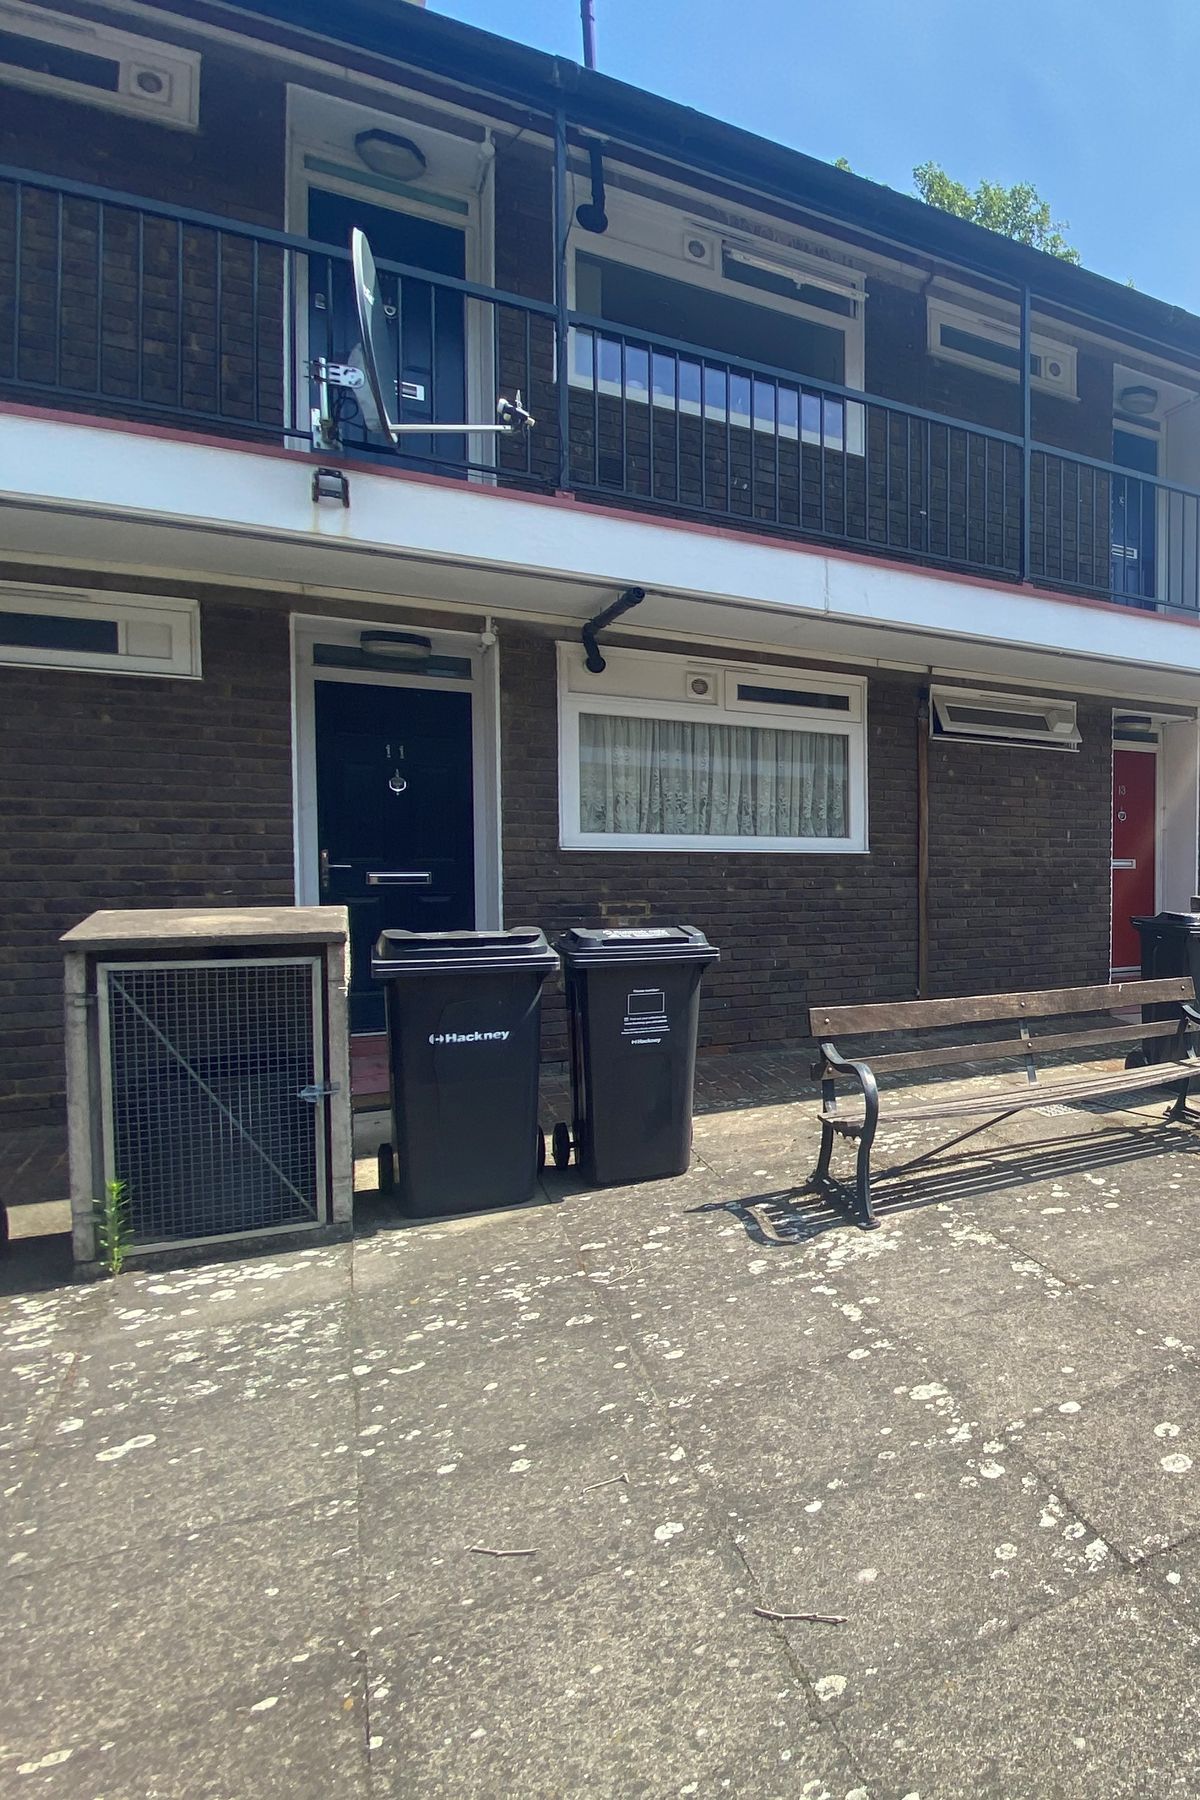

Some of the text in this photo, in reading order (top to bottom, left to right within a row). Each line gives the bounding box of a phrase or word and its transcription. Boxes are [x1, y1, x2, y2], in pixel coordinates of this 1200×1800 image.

[385, 744, 405, 760] 11
[1118, 784, 1126, 796] 13
[445, 1030, 510, 1044] Hackney
